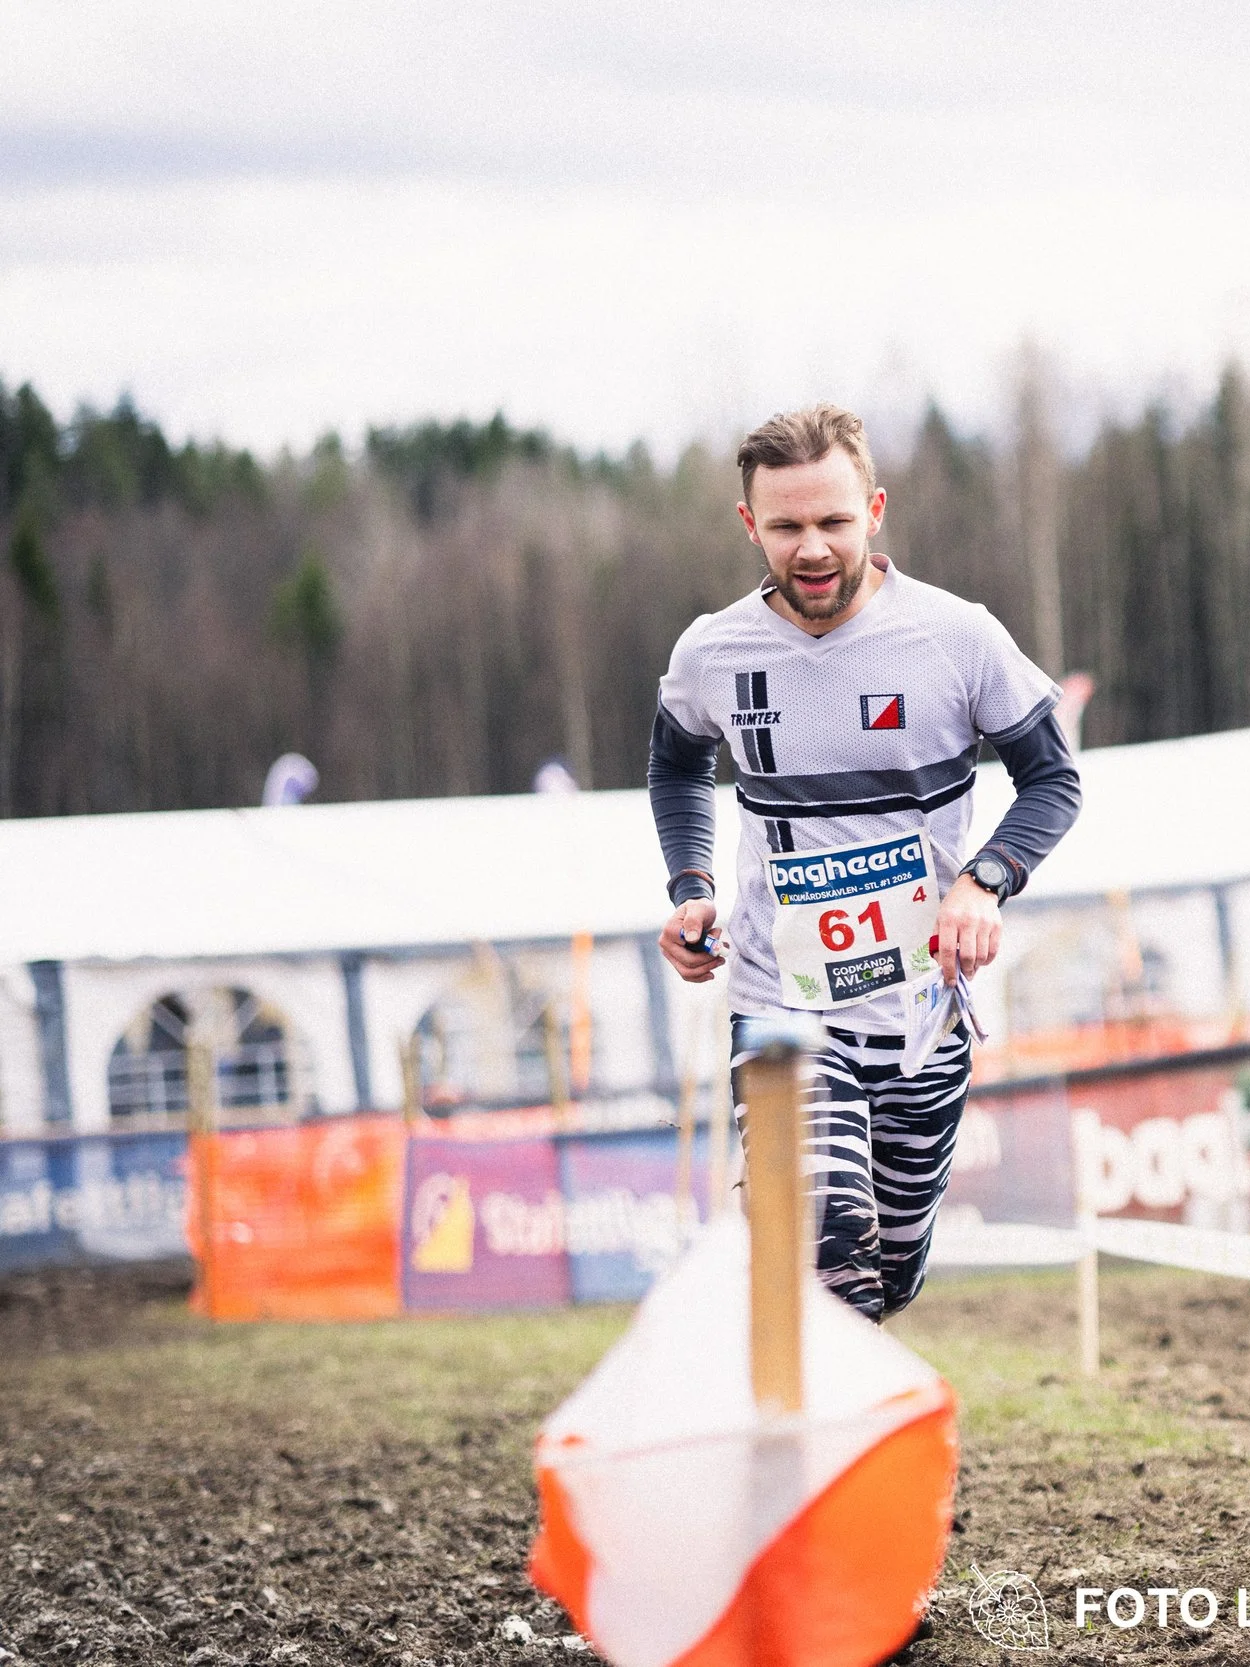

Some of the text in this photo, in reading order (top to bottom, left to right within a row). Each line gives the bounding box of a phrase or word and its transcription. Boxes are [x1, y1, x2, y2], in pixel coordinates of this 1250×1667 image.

[730, 711, 781, 726] TRIMTEX
[770, 841, 922, 888] bagheera
[788, 885, 858, 902] KOLMÅRDSKAVLEN
[864, 881, 880, 891] STL
[880, 878, 890, 888] #1
[892, 871, 913, 884] 2026
[912, 885, 928, 902] 4
[818, 900, 888, 952] 61
[832, 955, 895, 976] GODKÄNDA
[835, 965, 895, 989] AVLOPP
[849, 980, 880, 994] SVERIGE
